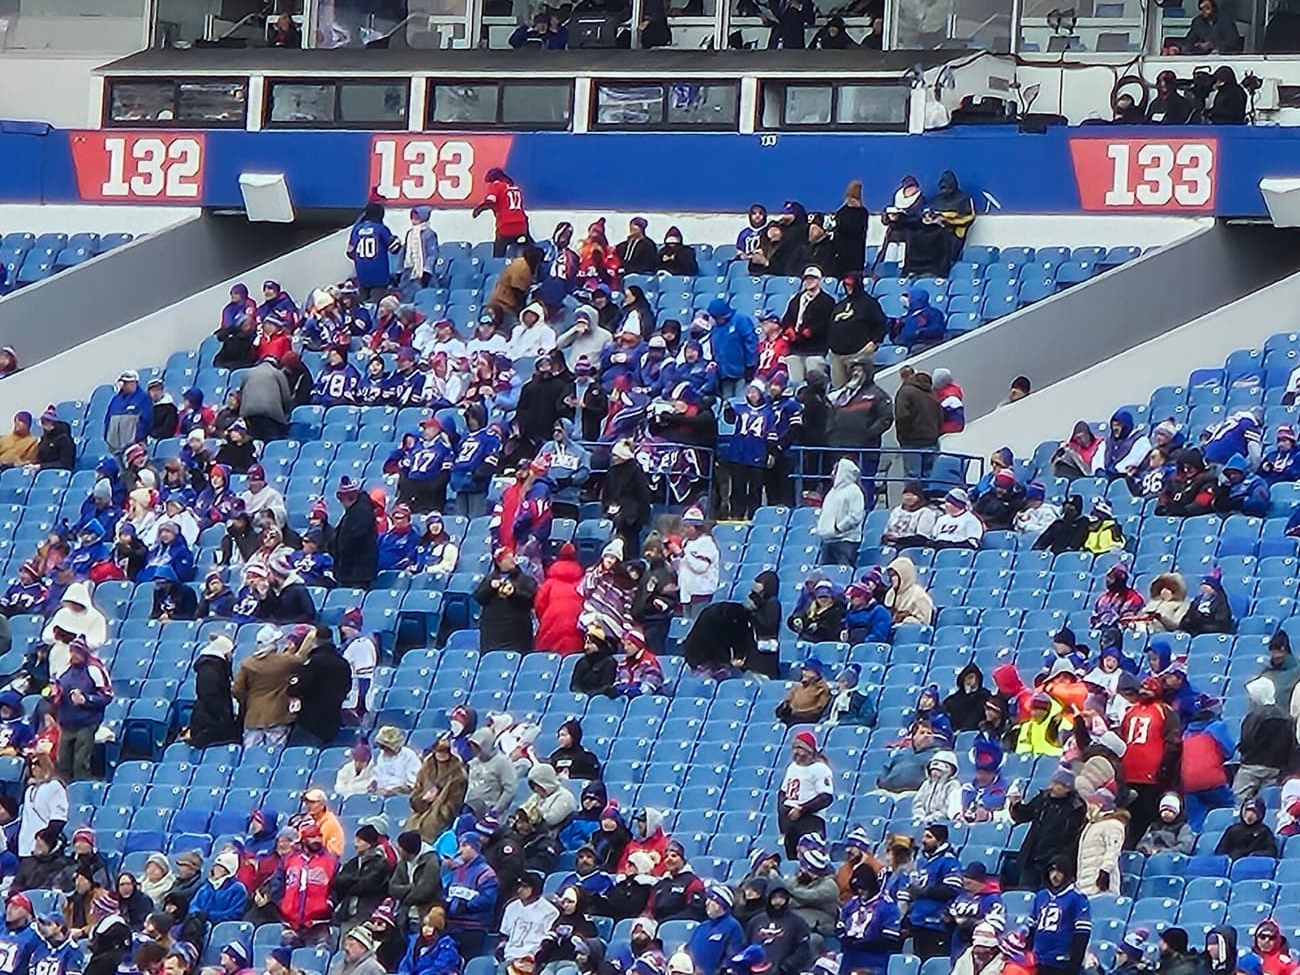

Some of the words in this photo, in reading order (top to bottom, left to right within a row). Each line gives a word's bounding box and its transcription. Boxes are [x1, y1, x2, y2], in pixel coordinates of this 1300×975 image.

[101, 136, 202, 198] 132
[373, 138, 476, 200] 133
[1104, 143, 1214, 207] 133
[355, 237, 377, 258] 40
[739, 414, 763, 437] 14
[411, 450, 436, 473] 17
[1129, 716, 1152, 744] 13
[1036, 905, 1060, 931] 12
